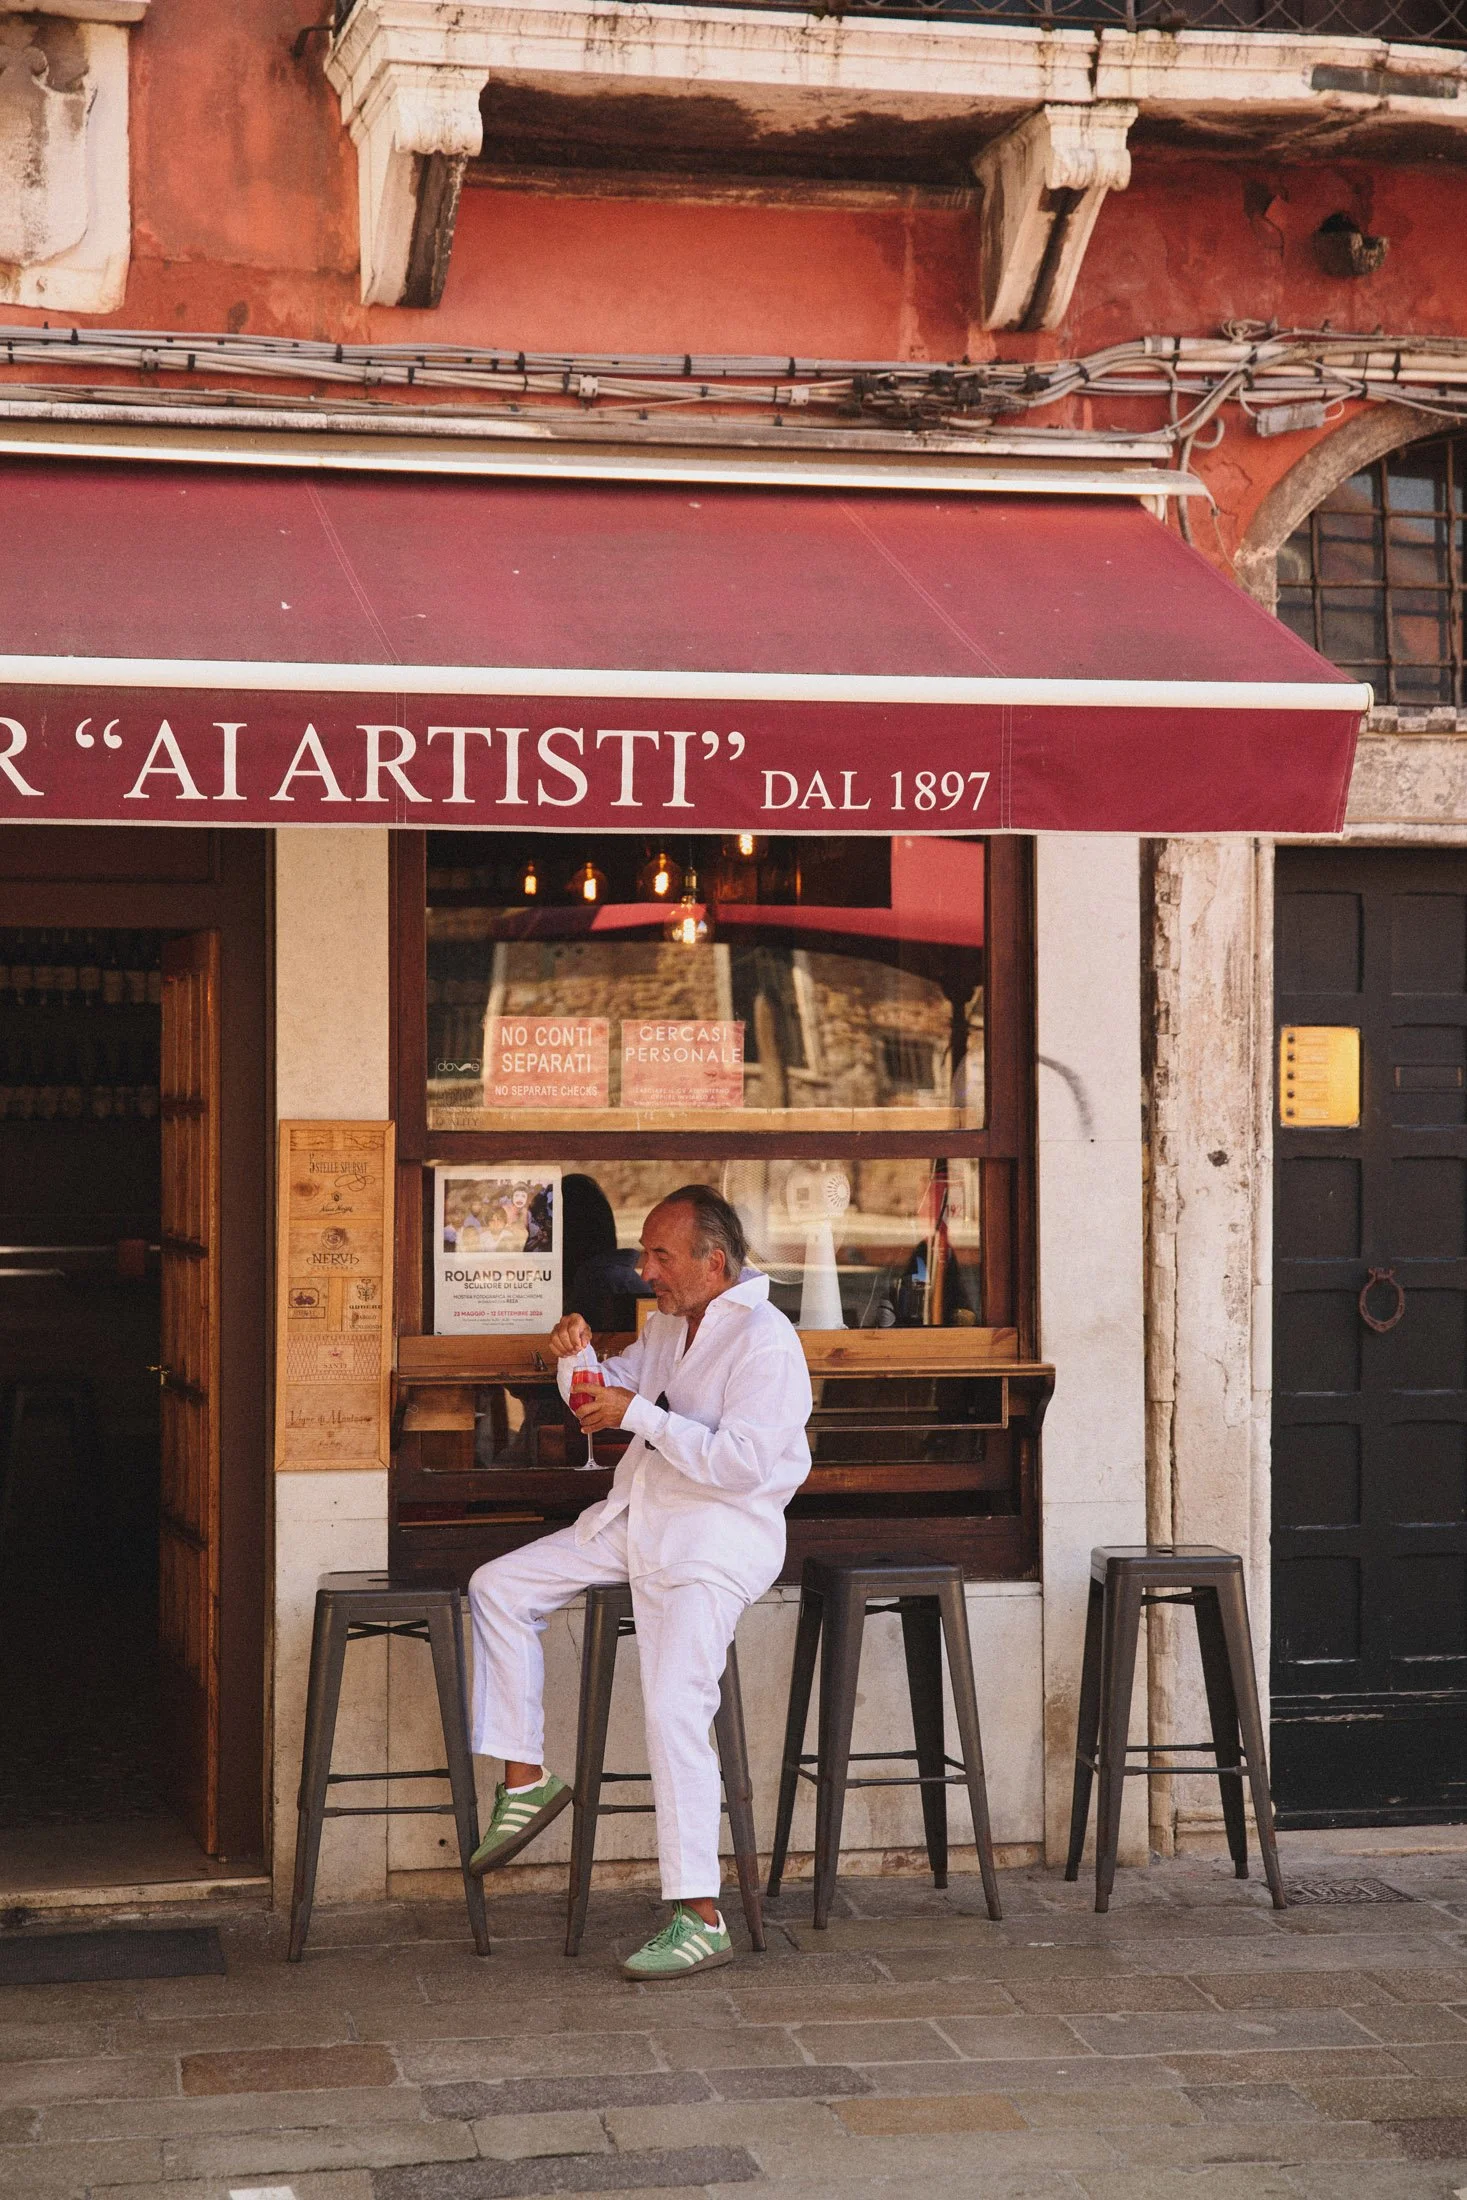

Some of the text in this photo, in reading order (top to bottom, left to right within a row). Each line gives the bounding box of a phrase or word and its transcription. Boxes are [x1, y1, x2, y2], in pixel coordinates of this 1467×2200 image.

[760, 769, 871, 811] DAL
[890, 770, 991, 811] 1897
[501, 1025, 592, 1048] NO CONTI
[639, 1025, 727, 1042] CERCASI
[501, 1052, 591, 1073] SEPARATI
[625, 1047, 742, 1063] PERSONALE
[495, 1085, 509, 1097] NO
[511, 1085, 558, 1097] SEPARATE
[306, 1253, 360, 1265] NERVI
[444, 1269, 552, 1283] ROLAND DUFAU
[503, 1282, 512, 1290] DI
[513, 1282, 533, 1290] LUCE
